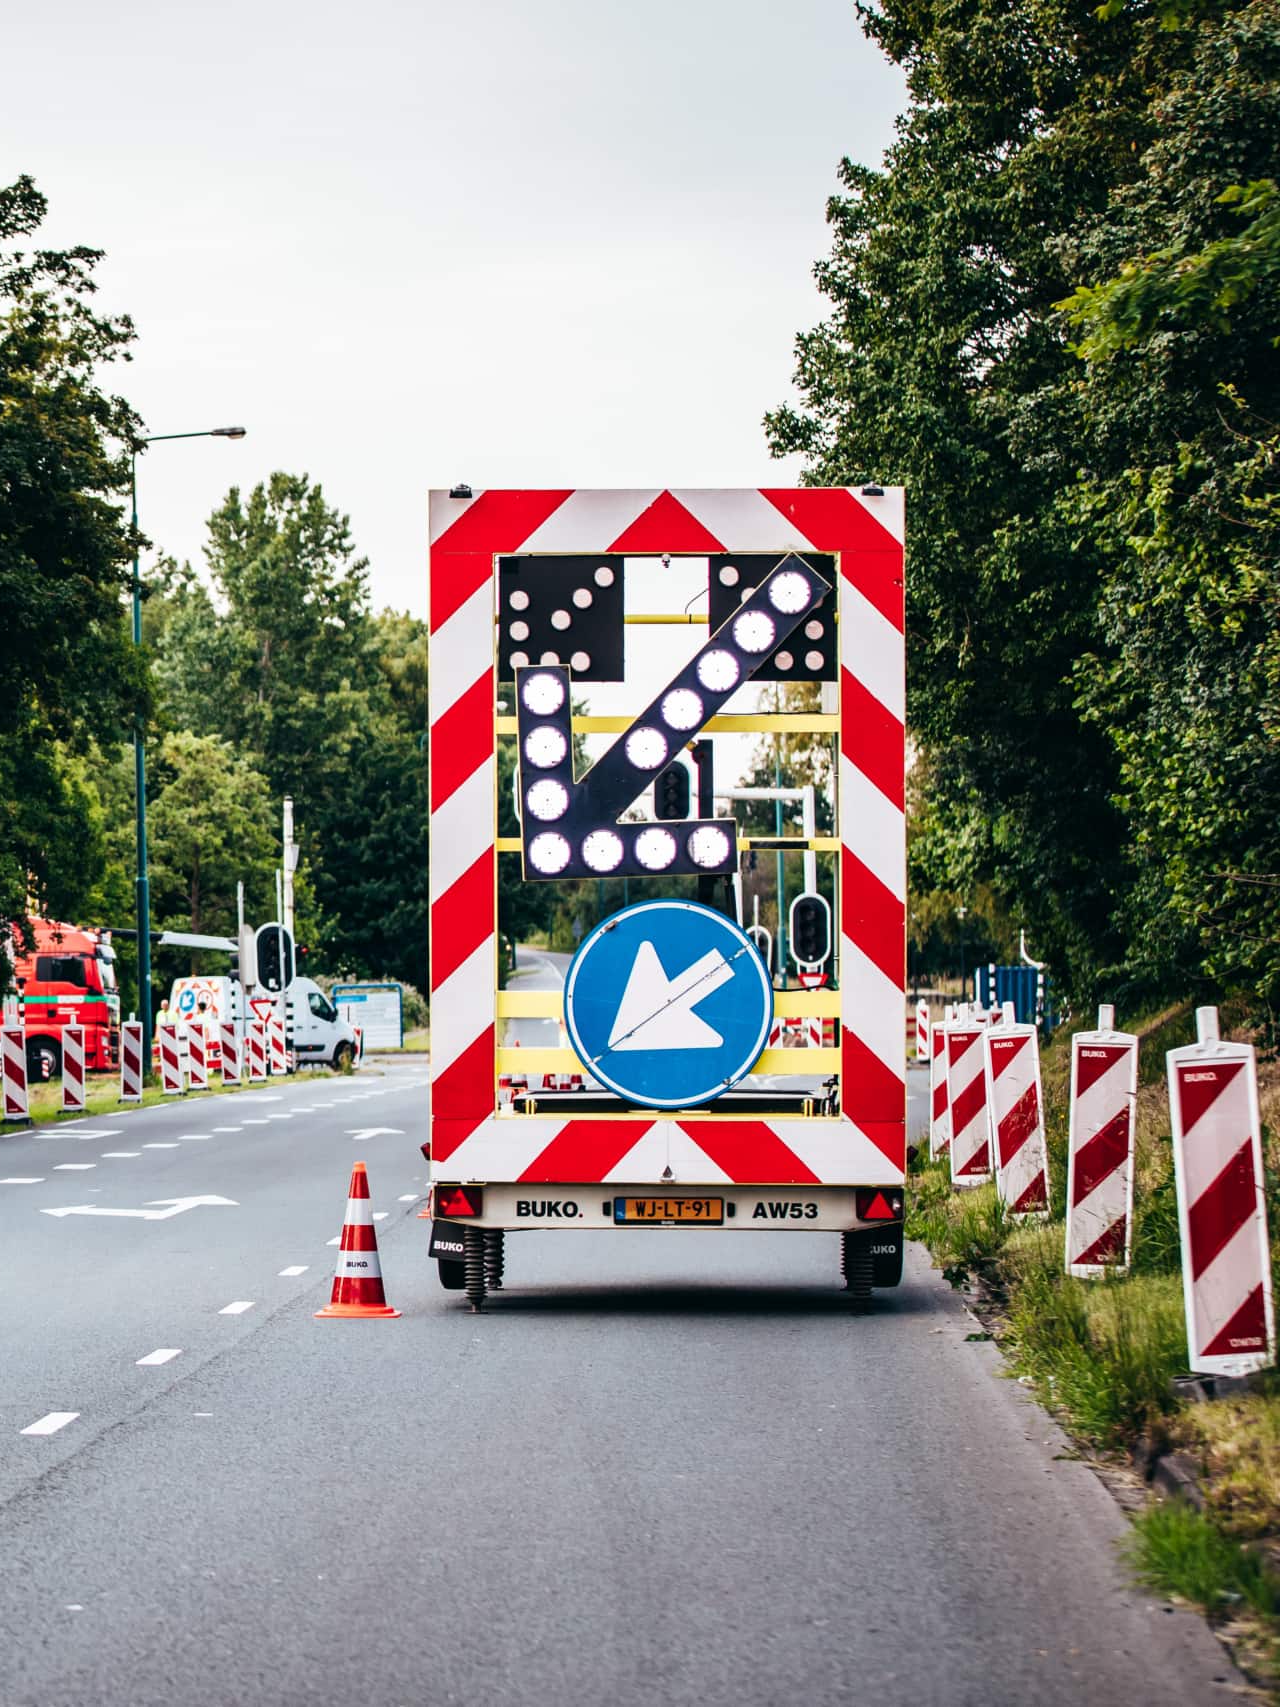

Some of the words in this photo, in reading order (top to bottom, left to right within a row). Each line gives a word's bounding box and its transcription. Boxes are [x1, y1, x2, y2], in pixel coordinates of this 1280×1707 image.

[516, 1200, 584, 1218] BUKO.
[635, 1201, 711, 1217] WJ-LT-91
[752, 1202, 819, 1219] AW53
[869, 1245, 897, 1254] UKO
